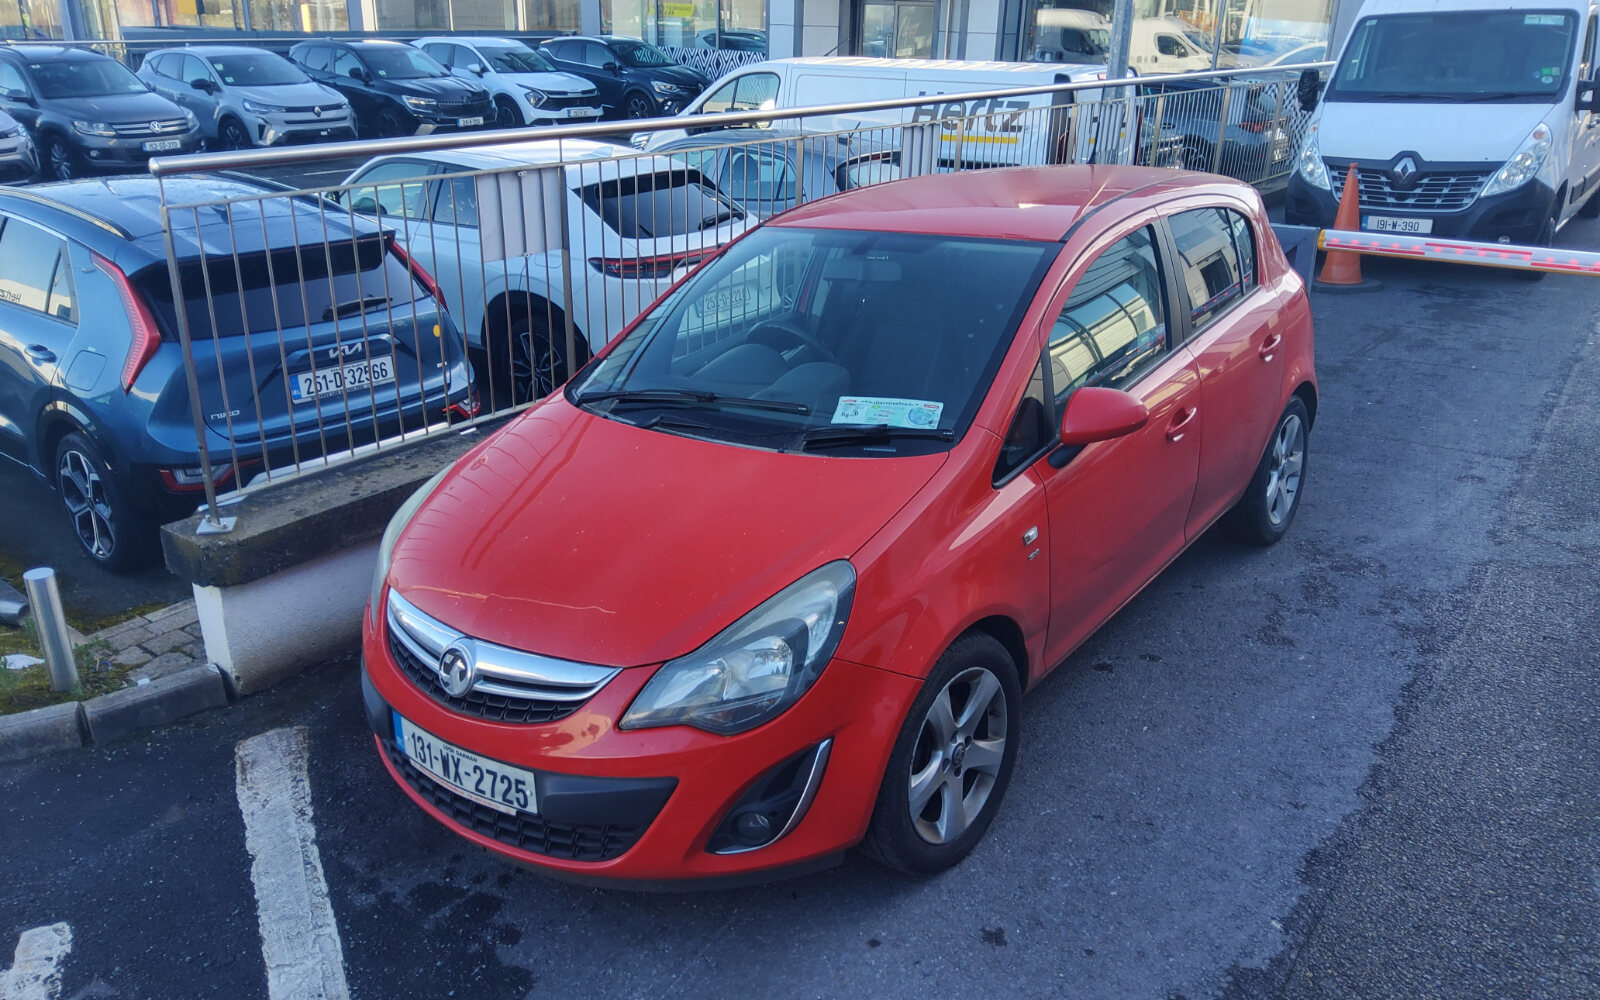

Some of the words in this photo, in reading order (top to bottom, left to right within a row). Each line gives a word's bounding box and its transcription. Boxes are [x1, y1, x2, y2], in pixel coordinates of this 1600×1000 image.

[910, 91, 1029, 132] Hertz
[1376, 219, 1420, 232] 191-W-390
[304, 362, 388, 395] 251-D-32566
[411, 731, 529, 809] 131-WX-2725
